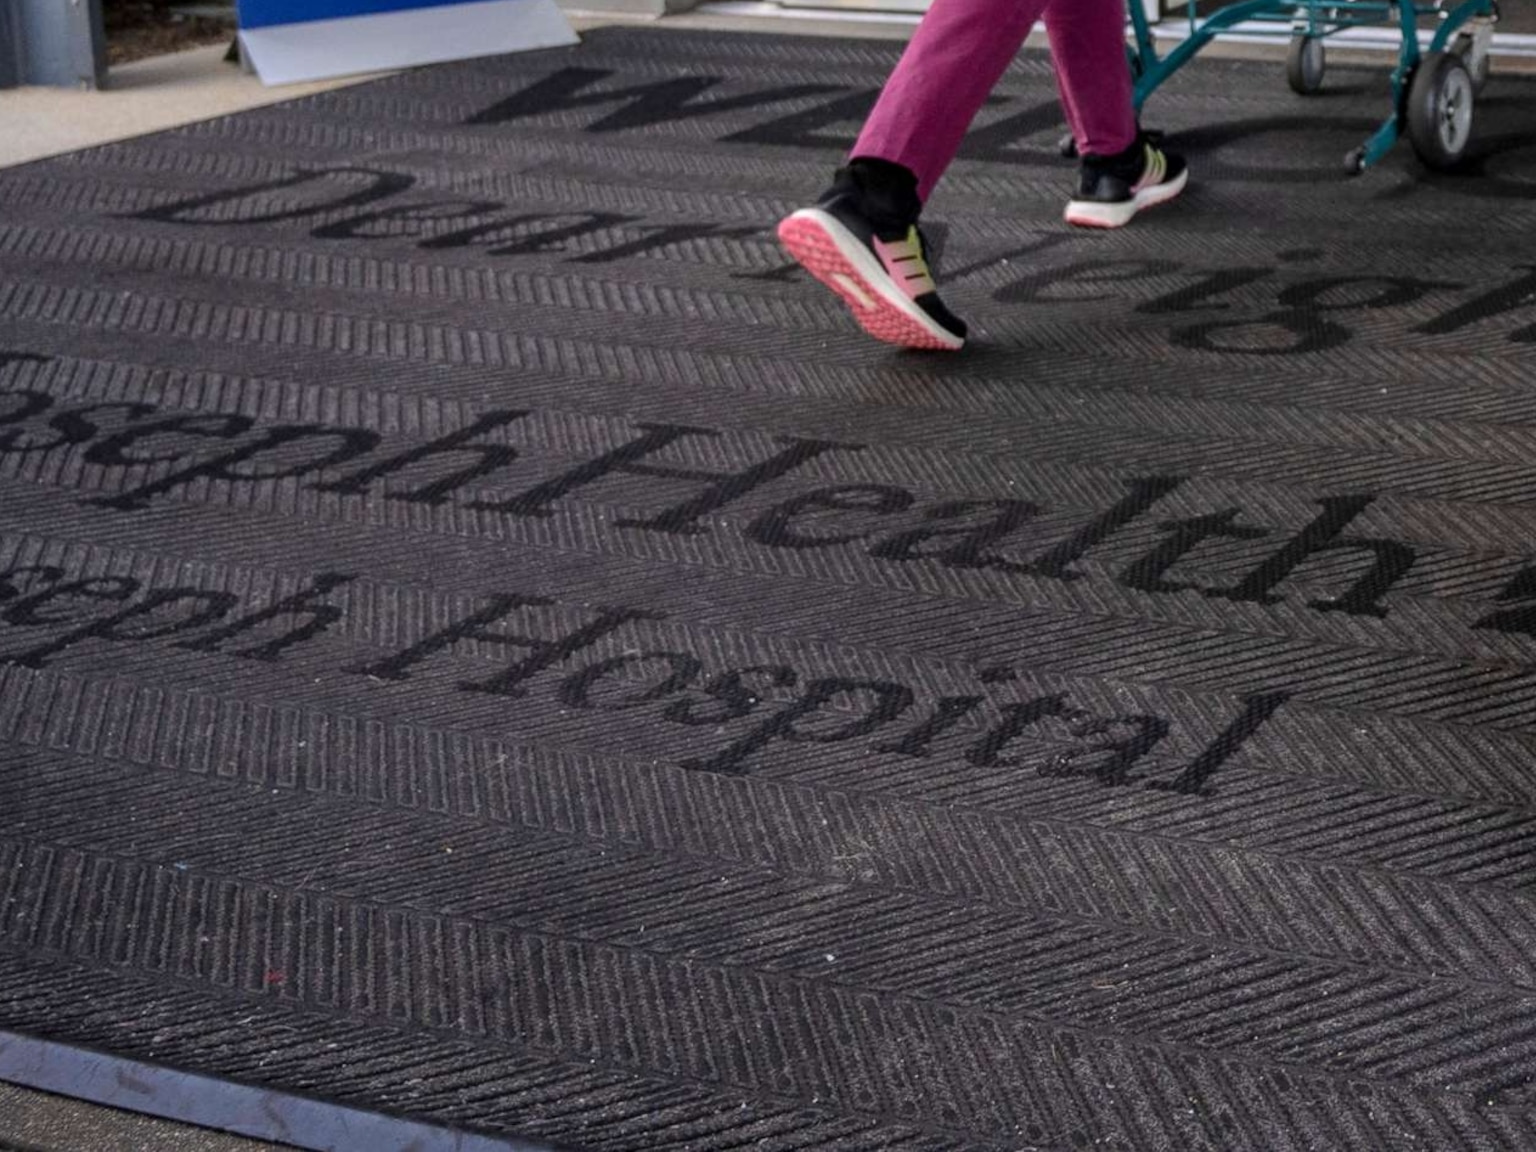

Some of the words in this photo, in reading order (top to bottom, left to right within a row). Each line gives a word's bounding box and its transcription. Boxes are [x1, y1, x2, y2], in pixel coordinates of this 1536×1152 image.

[108, 165, 775, 264] Dear
[464, 421, 1415, 619] Health
[338, 592, 1293, 796] Hospital
